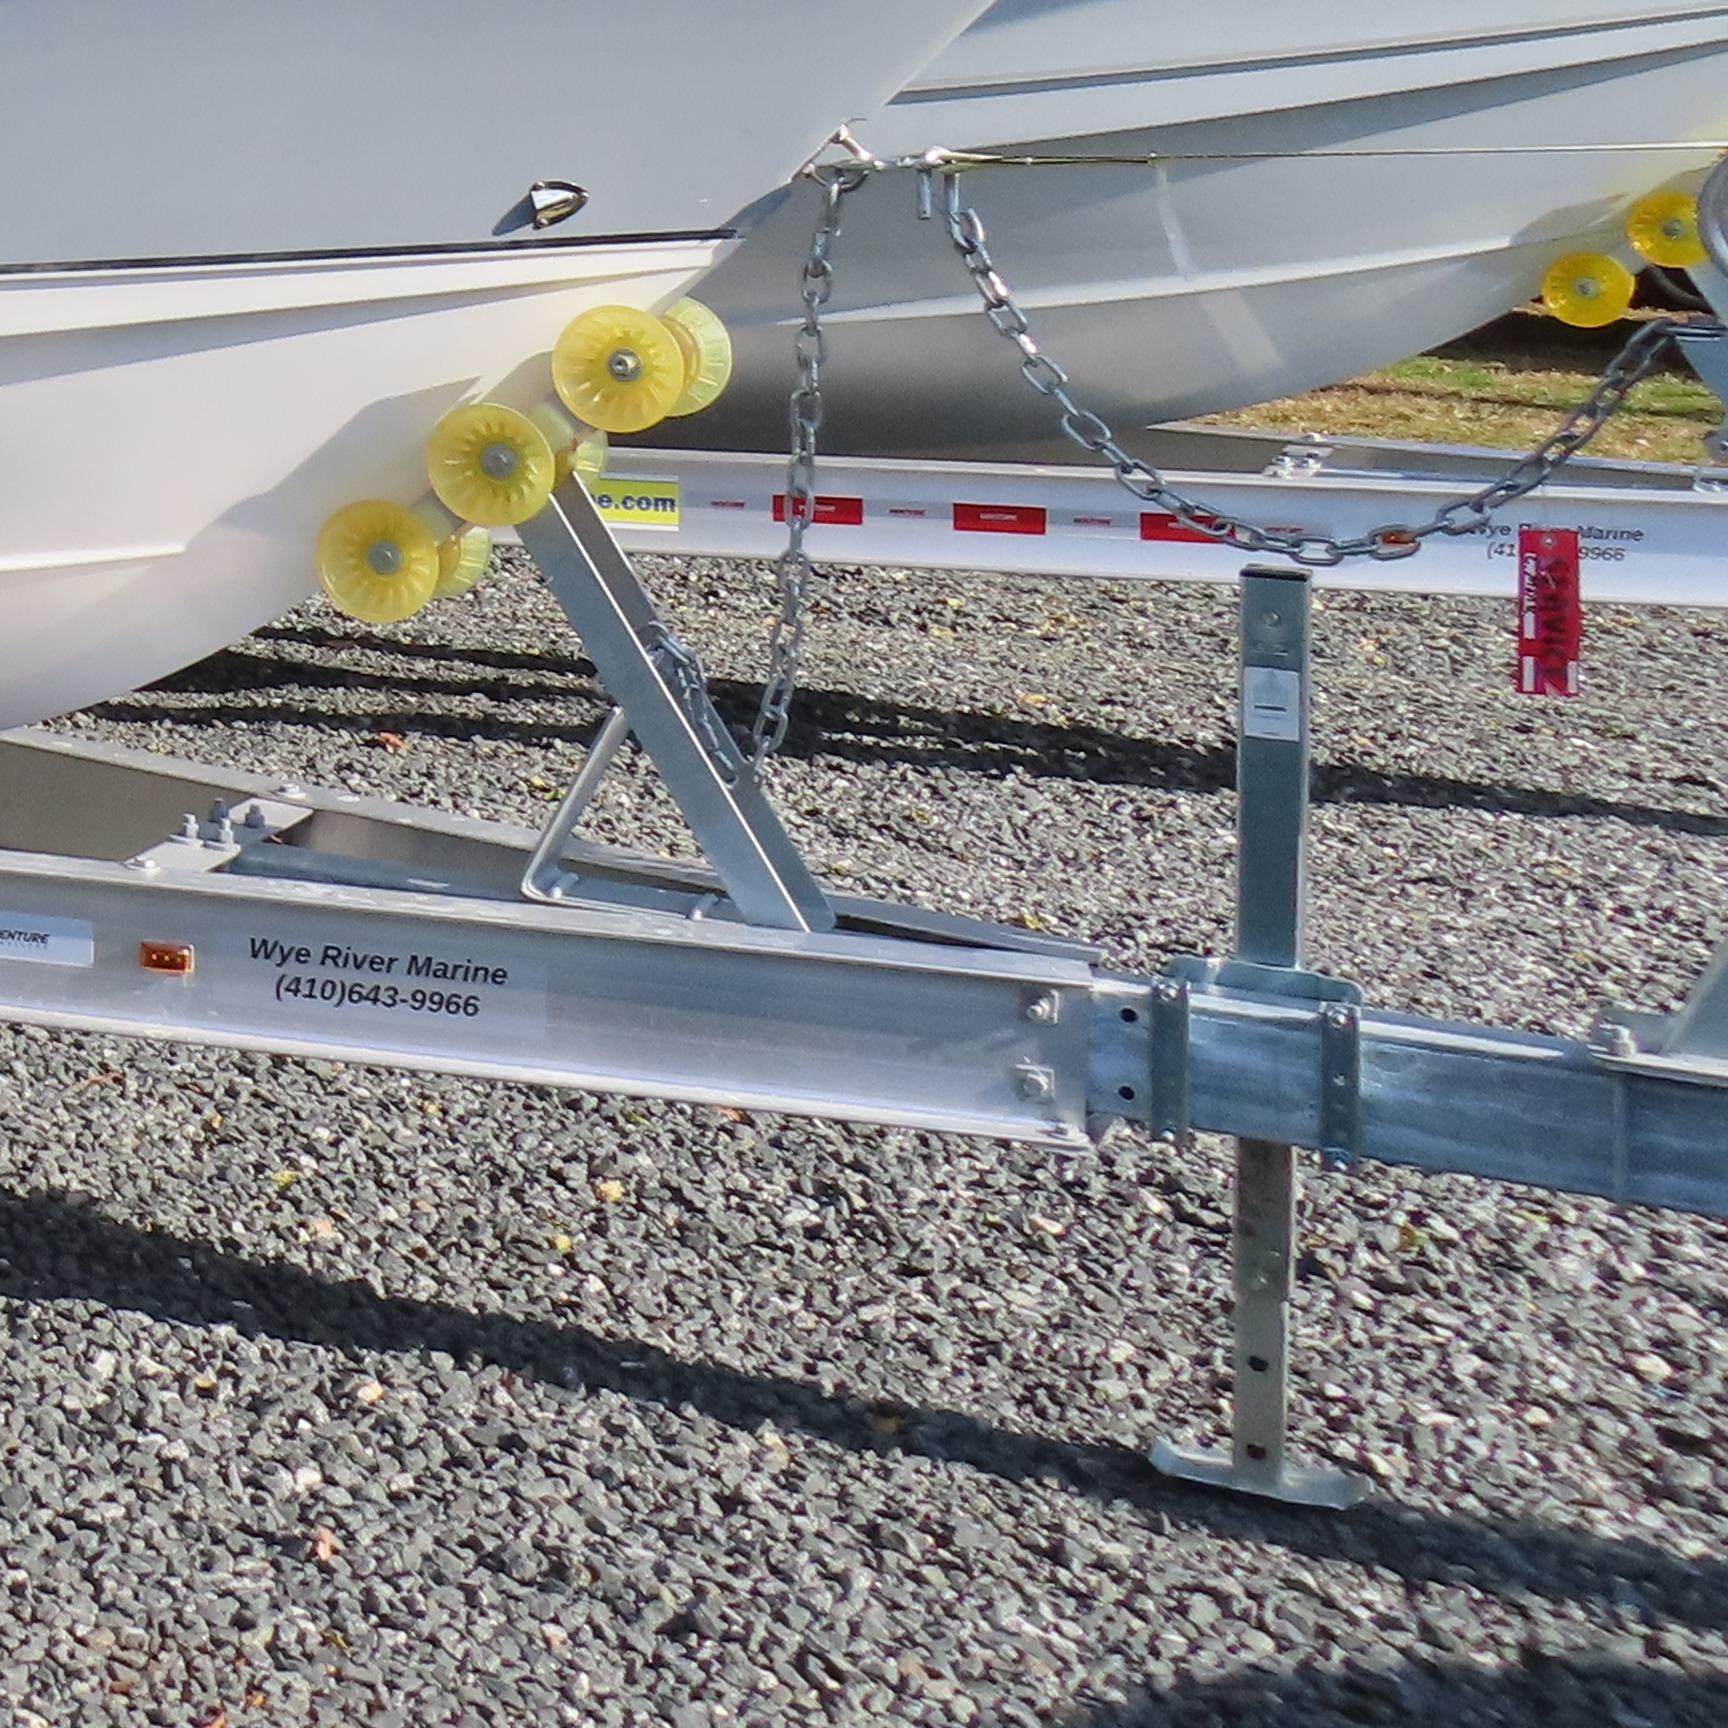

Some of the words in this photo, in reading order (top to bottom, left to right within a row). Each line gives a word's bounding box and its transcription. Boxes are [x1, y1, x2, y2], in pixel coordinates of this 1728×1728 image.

[249, 936, 312, 969] Wye
[320, 944, 398, 974] River
[406, 954, 508, 986] Marine
[275, 974, 481, 1018] (410)643-9966
